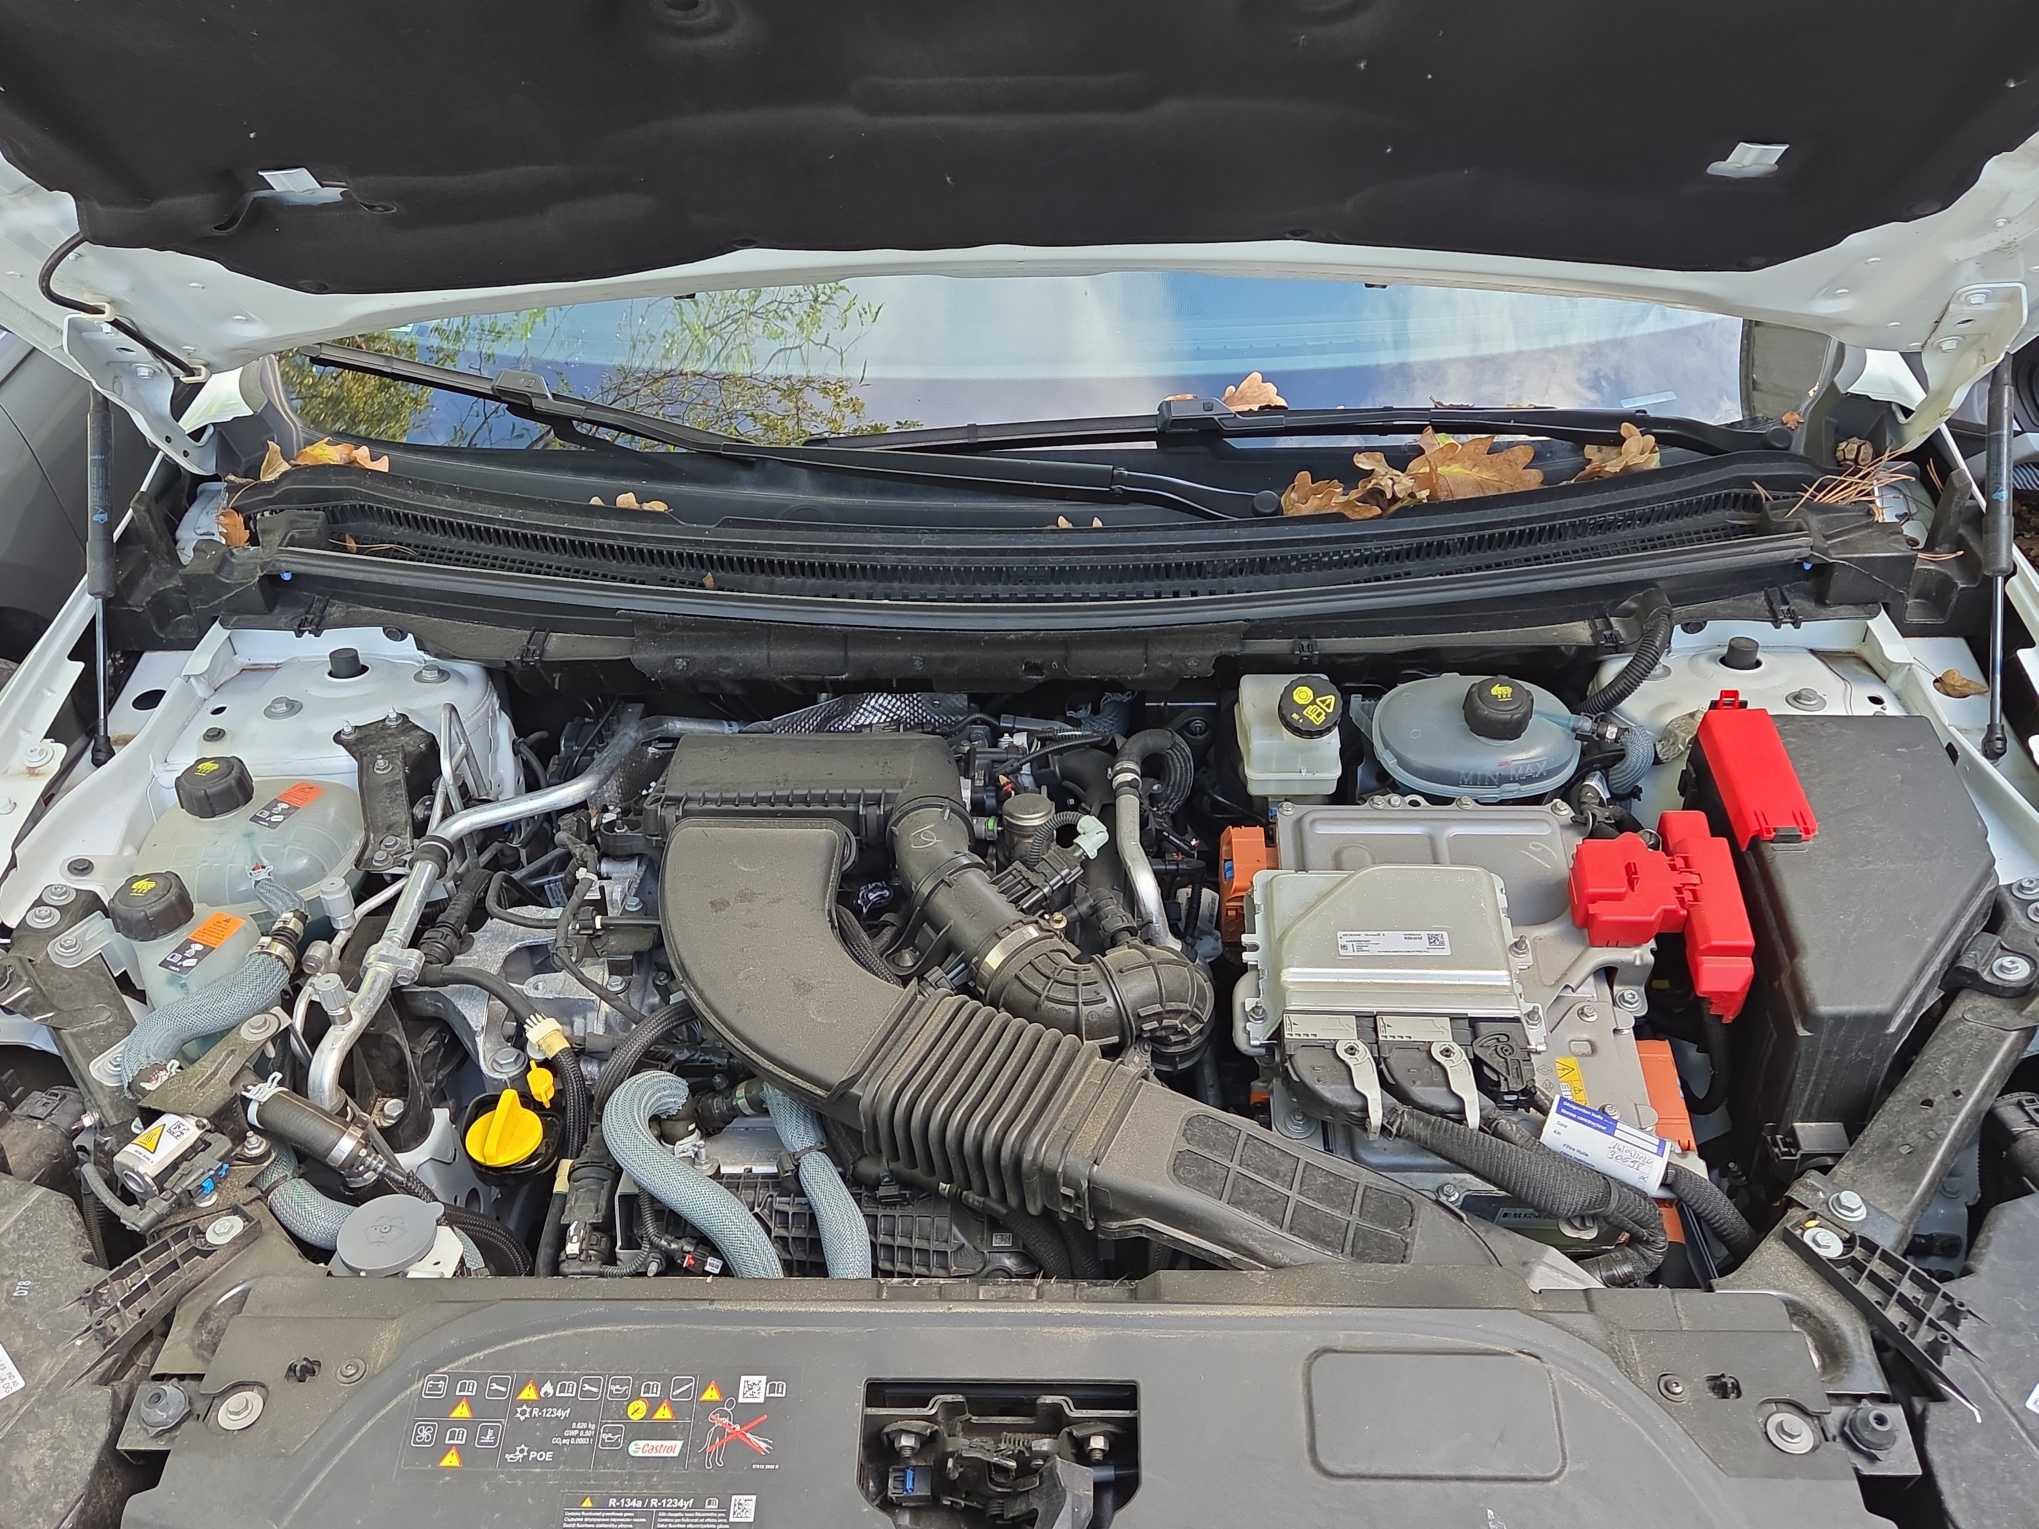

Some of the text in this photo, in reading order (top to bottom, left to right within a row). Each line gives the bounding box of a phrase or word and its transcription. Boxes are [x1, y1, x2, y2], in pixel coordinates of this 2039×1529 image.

[531, 1407, 571, 1420] R-1234yf
[641, 1443, 677, 1455] Castrol
[528, 1451, 554, 1461] POE
[608, 1498, 642, 1508] R-134a
[650, 1498, 695, 1510] R-1234yf
